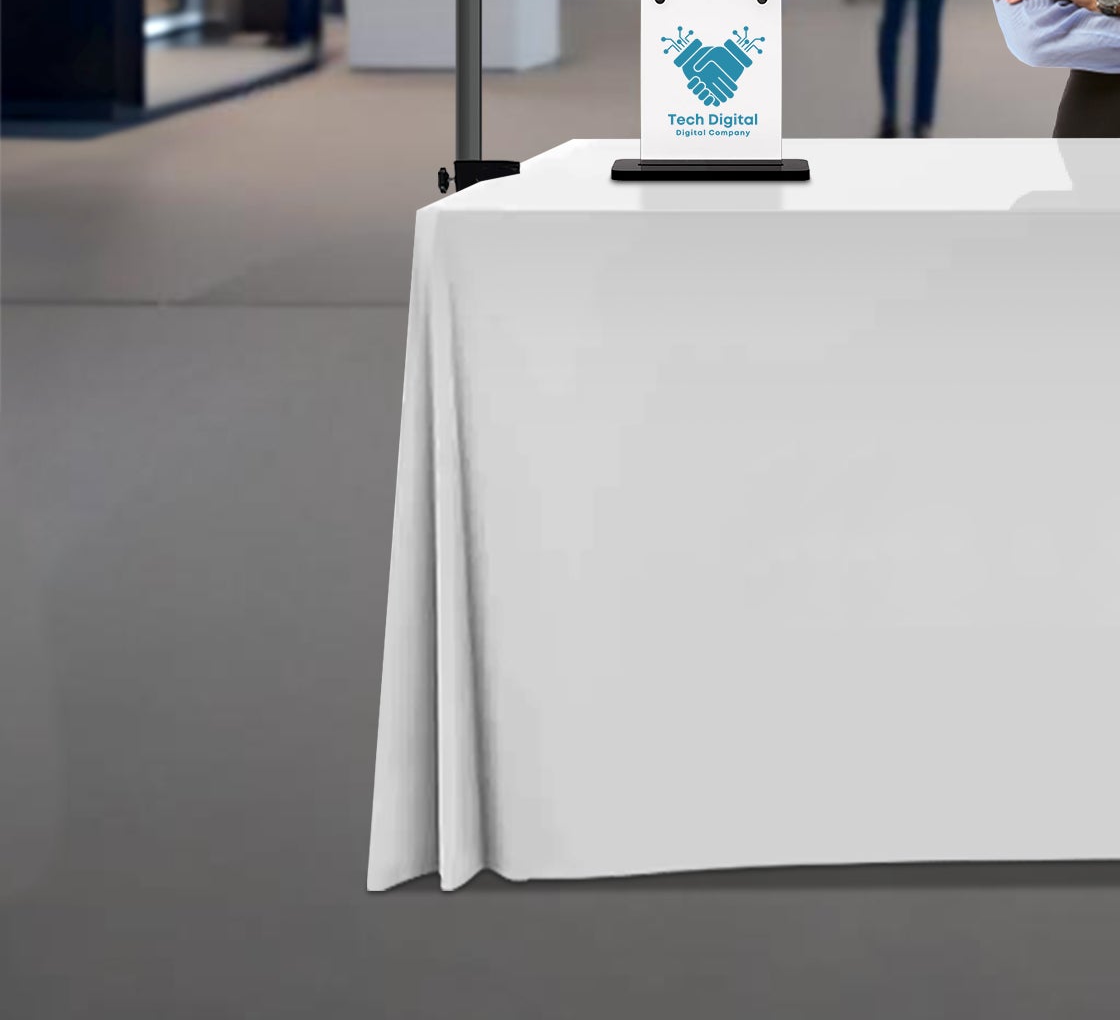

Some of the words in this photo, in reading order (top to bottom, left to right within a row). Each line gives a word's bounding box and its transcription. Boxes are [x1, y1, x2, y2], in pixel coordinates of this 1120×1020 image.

[667, 113, 704, 125] Tech
[708, 113, 758, 128] Digital
[675, 129, 706, 137] Digital
[708, 129, 751, 137] Company
